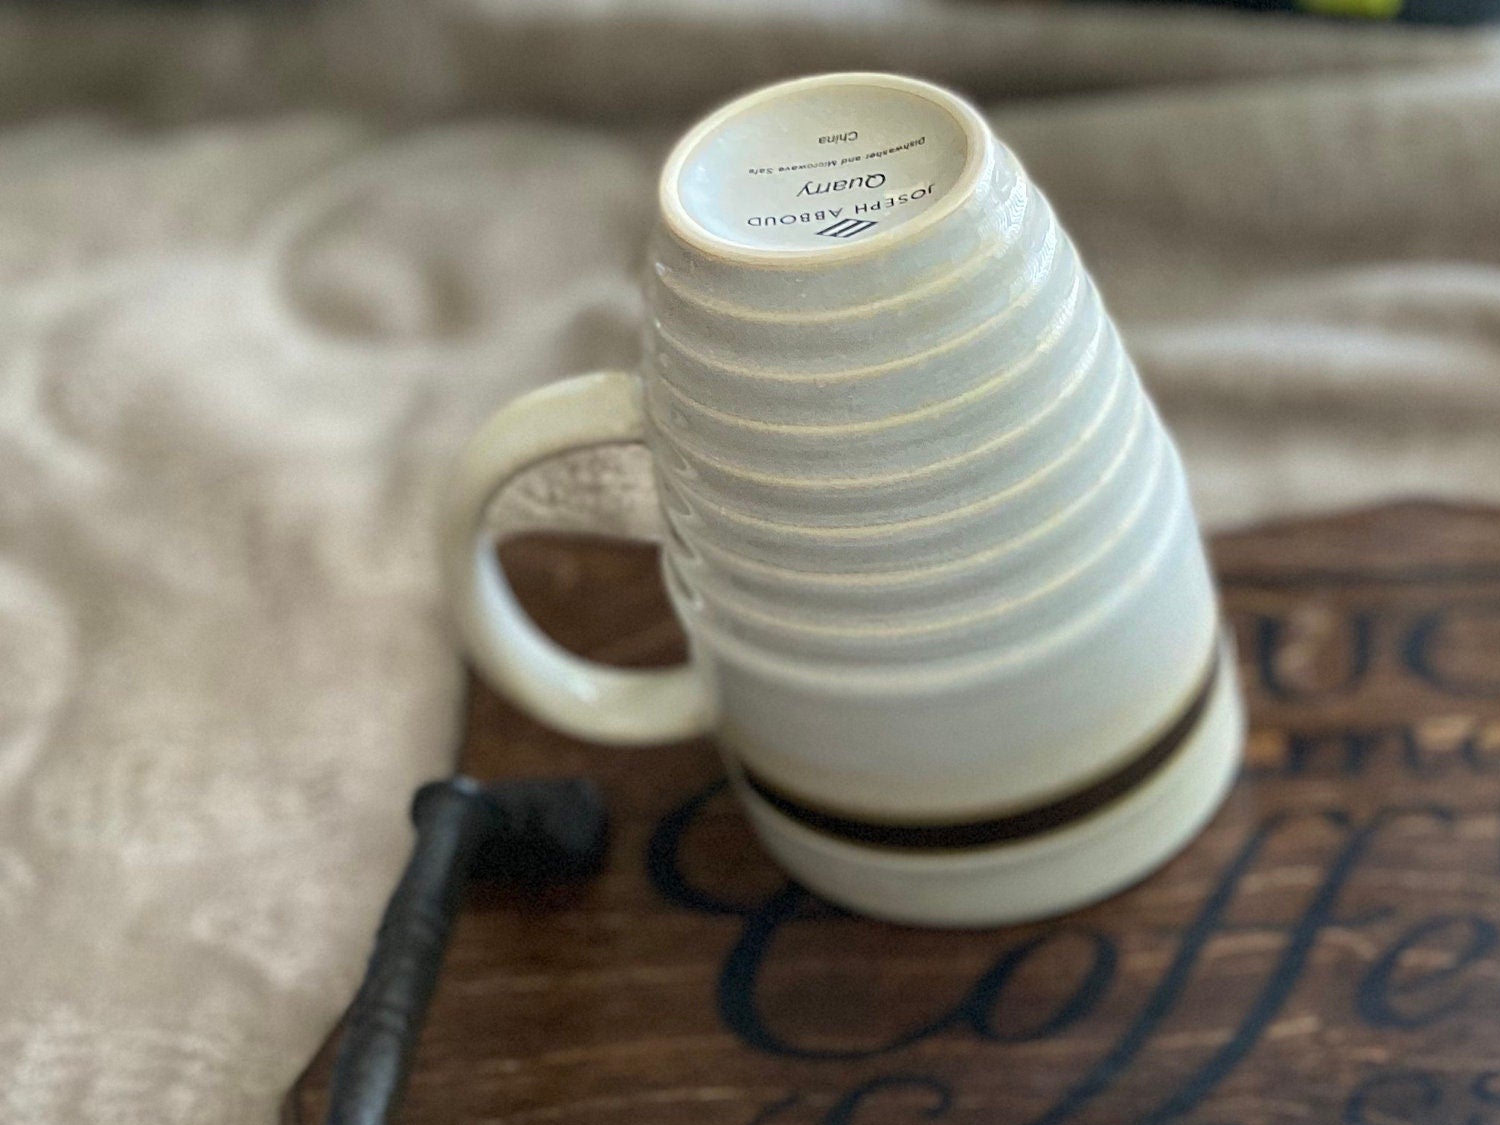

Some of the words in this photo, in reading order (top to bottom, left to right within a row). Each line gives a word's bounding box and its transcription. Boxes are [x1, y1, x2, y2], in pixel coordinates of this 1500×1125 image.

[818, 131, 858, 145] China
[865, 136, 926, 160] Dishwasher
[778, 160, 838, 172] Microwave
[841, 156, 861, 166] and
[748, 167, 773, 175] Safe
[796, 173, 886, 197] Quarry
[855, 183, 936, 215] JOSEPH
[747, 208, 843, 227] ABBOUD
